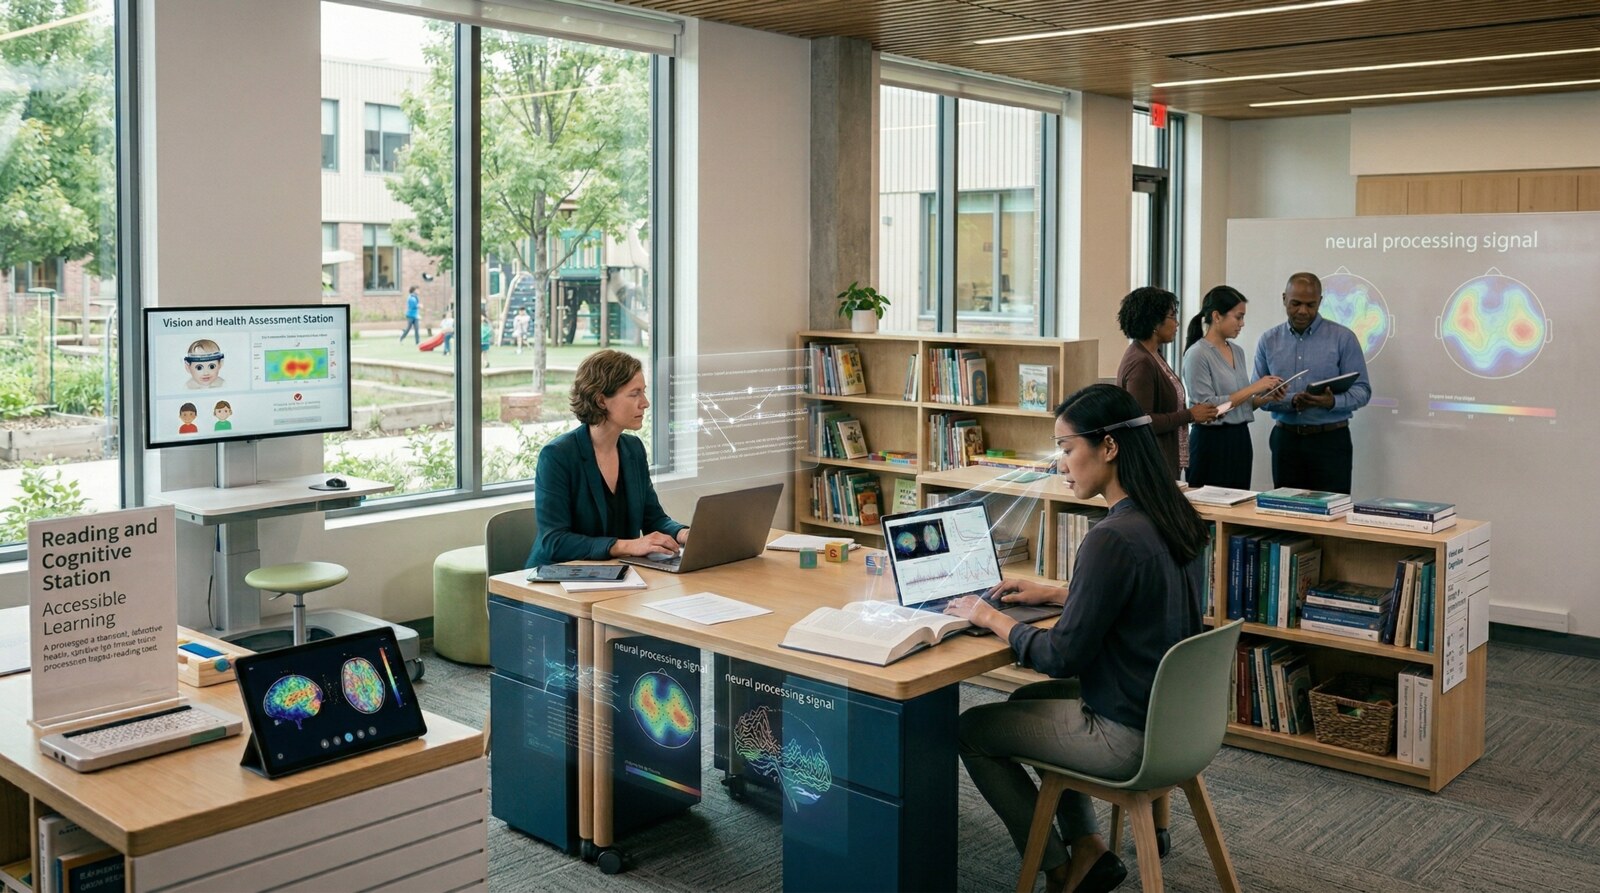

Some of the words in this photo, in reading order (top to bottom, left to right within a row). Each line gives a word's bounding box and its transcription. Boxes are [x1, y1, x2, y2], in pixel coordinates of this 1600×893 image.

[1326, 233, 1377, 249] neural
[1383, 232, 1478, 252] processing
[1483, 230, 1538, 252] signal
[163, 317, 193, 328] Vision
[196, 316, 214, 327] and
[216, 315, 247, 326] Health
[249, 314, 301, 325] Assessment
[303, 313, 334, 324] Station
[42, 525, 119, 548] Reading
[124, 517, 158, 538] and
[42, 544, 132, 570] Cognitive
[42, 569, 111, 591] Station
[42, 591, 127, 617] Accessible
[43, 613, 116, 636] Learning
[614, 642, 639, 656] neural
[640, 648, 682, 670] processing
[683, 658, 708, 674] signal
[725, 673, 753, 688] neural
[755, 680, 805, 703] processing
[806, 694, 835, 710] signal
